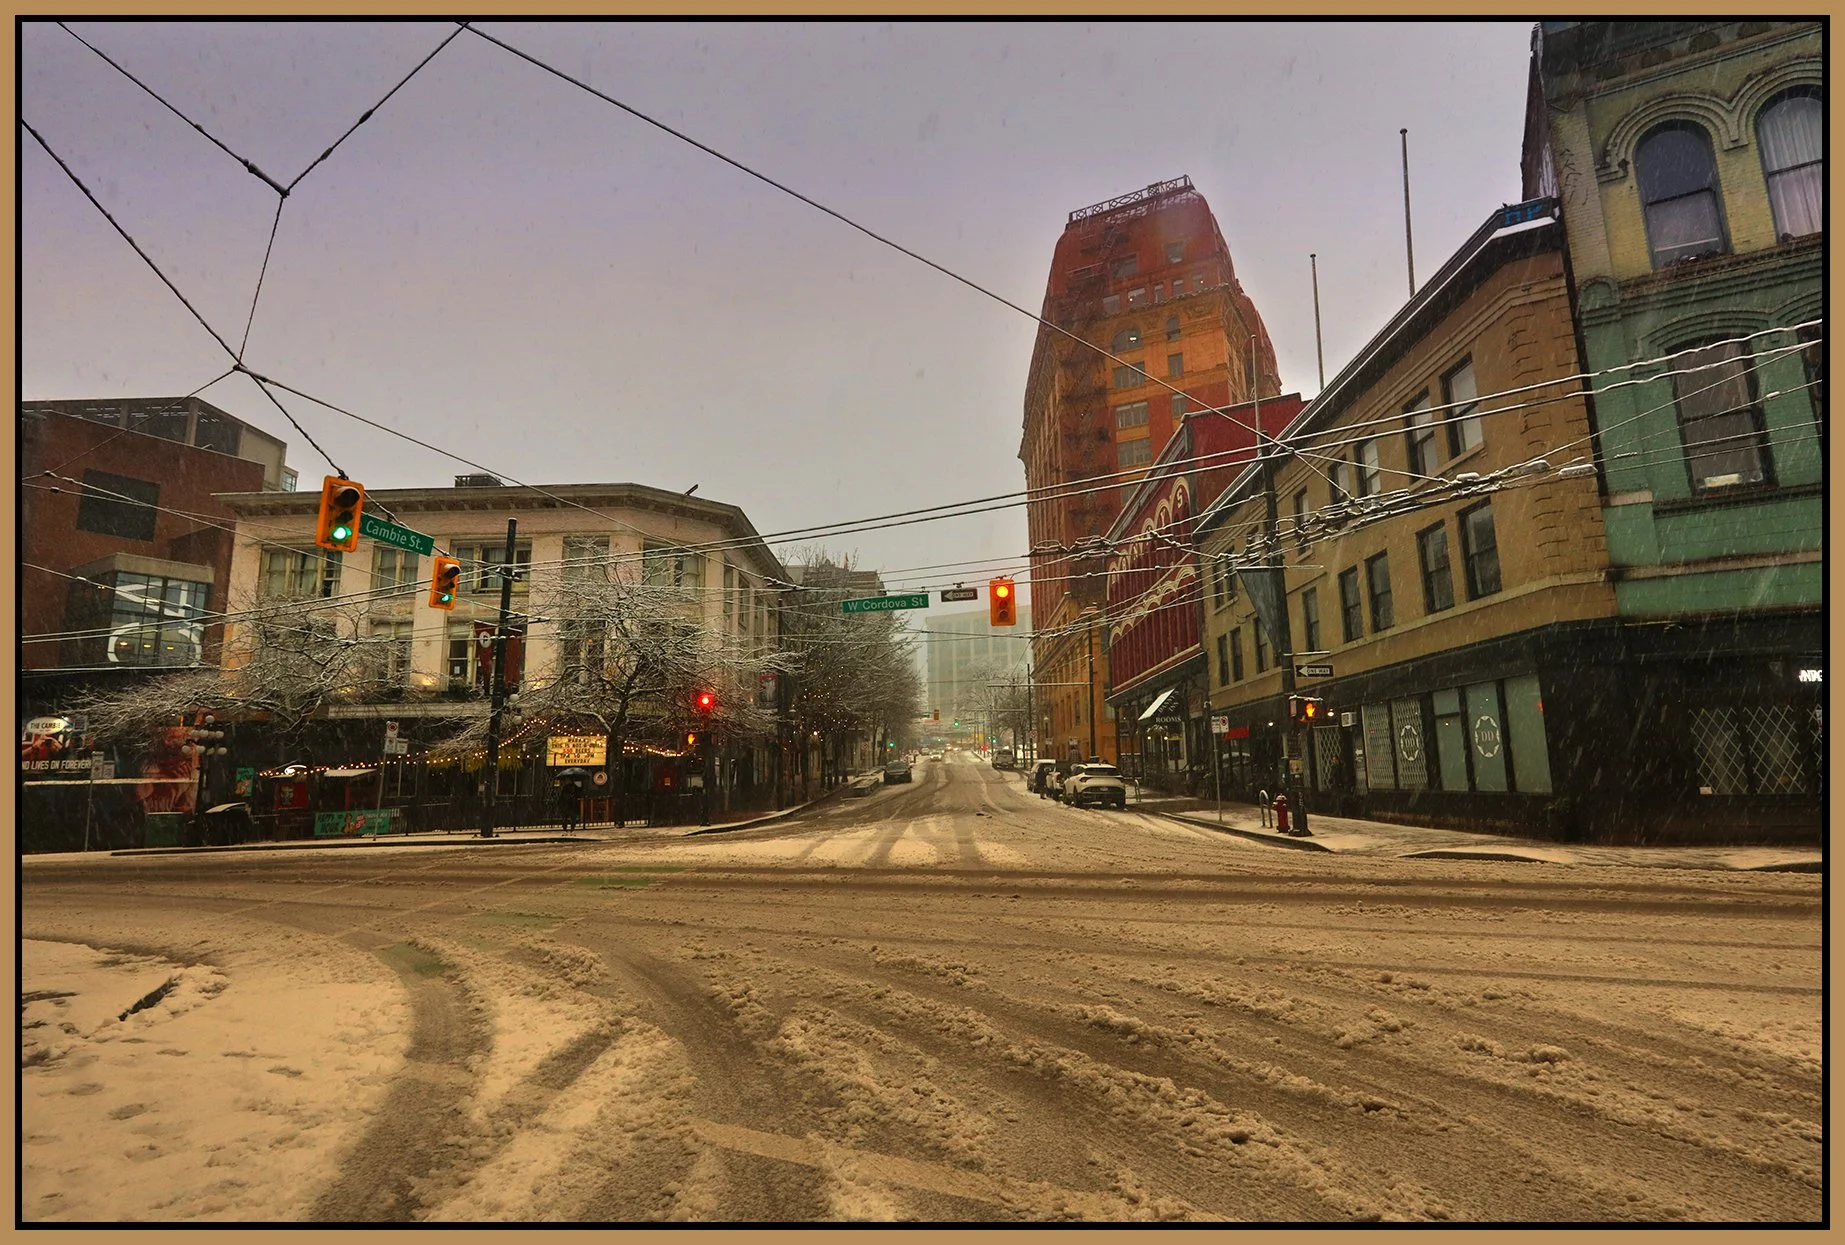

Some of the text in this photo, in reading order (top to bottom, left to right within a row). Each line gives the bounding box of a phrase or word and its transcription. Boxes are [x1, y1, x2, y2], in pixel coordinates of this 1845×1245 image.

[366, 520, 424, 551] Cambie St.
[847, 597, 924, 611] W Cordova St
[31, 760, 49, 769] LIVES
[50, 760, 59, 769] ON
